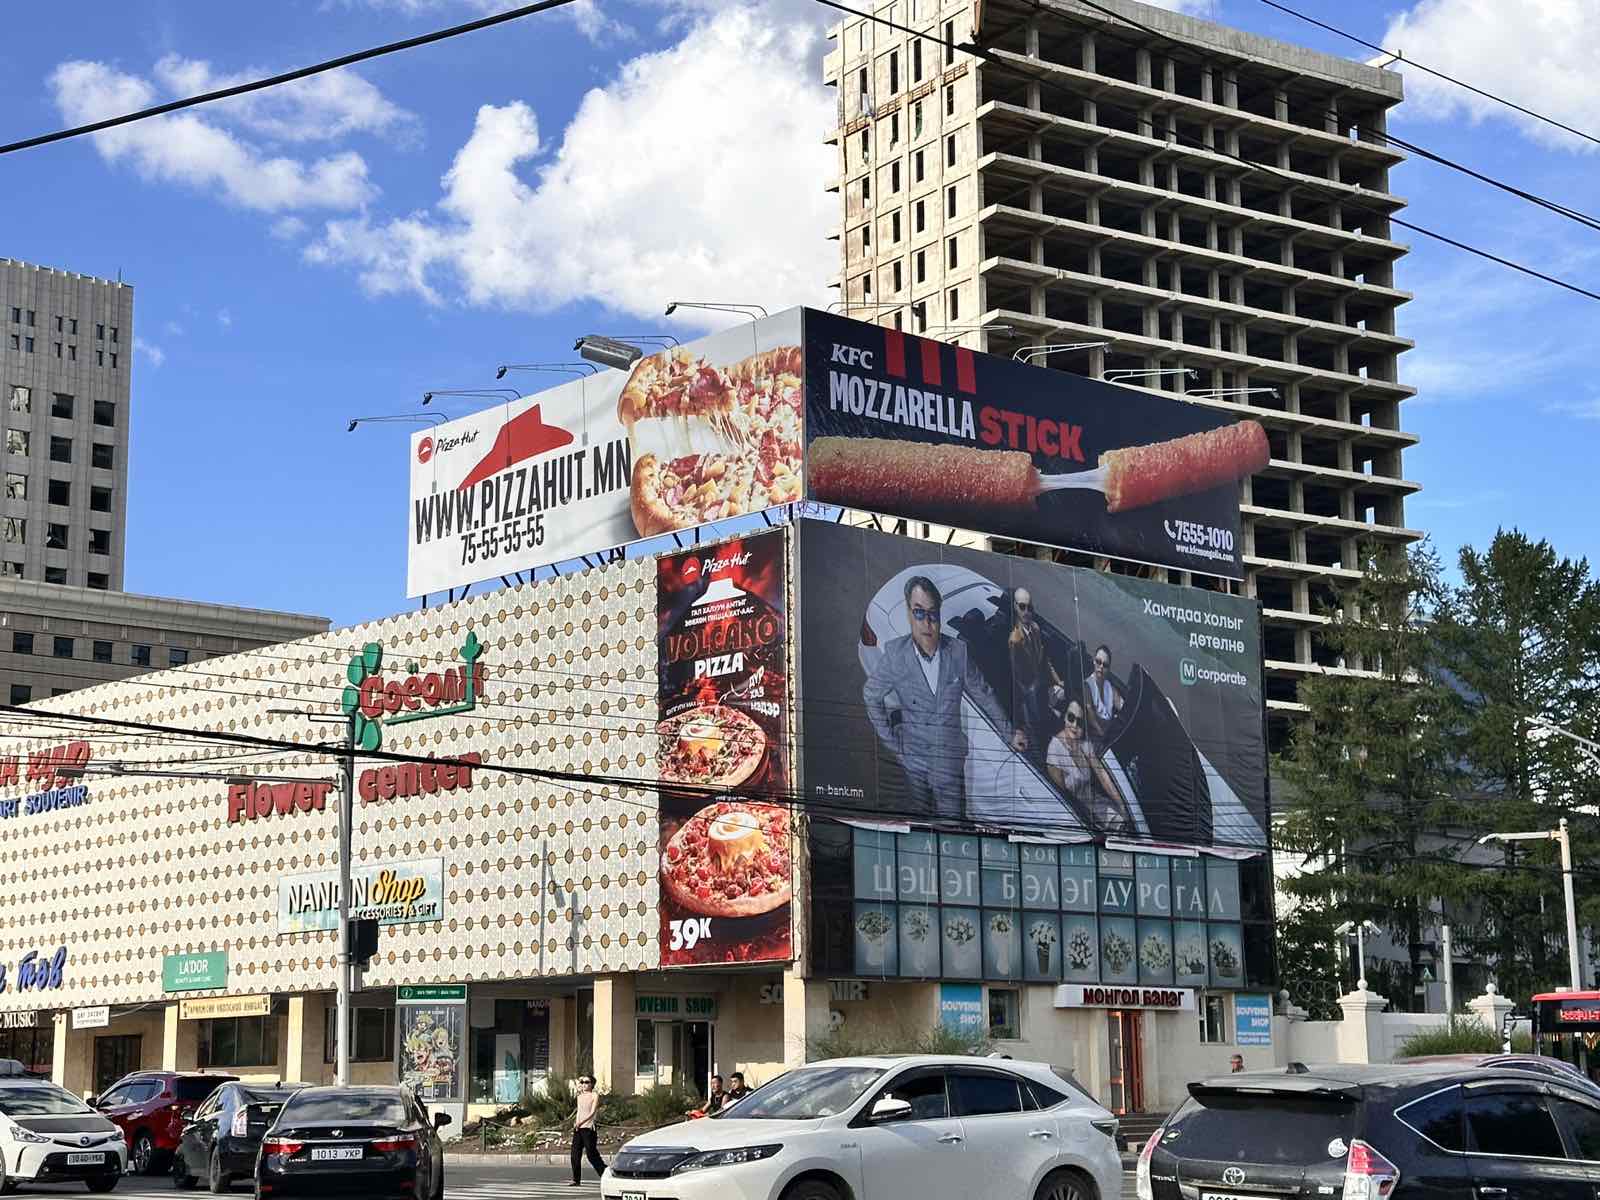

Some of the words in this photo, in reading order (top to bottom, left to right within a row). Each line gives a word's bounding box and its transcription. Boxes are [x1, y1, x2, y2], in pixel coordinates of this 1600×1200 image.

[830, 343, 873, 370] KFC
[829, 370, 976, 440] MOZZARELLA
[435, 436, 460, 455] Pizza
[461, 428, 480, 446] Hut
[980, 406, 1087, 463] STICK
[415, 437, 632, 545] WWW.PIZZAHUT.MN
[461, 514, 545, 566] 75-55-55-55
[1175, 519, 1234, 552] 7555-1010
[701, 556, 730, 576] Pizza
[730, 551, 752, 568] Hut
[1143, 598, 1201, 624] Хамтдаа
[1203, 611, 1244, 631] холыг
[667, 613, 779, 664] VOLCANO
[1189, 632, 1245, 654] дөтөлнө
[694, 651, 744, 680] PIZZA
[1197, 667, 1247, 686] corporate
[25, 785, 89, 816] SOUVENIR
[227, 780, 333, 823] Flower
[359, 751, 482, 802] center
[373, 868, 426, 919] Shop
[873, 863, 977, 898] ЦЭЦЭГ
[1002, 872, 1093, 904] БЭЛЭГ
[1103, 878, 1224, 913] ДУРСГАЛ
[418, 902, 437, 916] GIFT
[669, 917, 712, 951] 39K
[1083, 988, 1140, 1006] МОНГОЛ
[4, 1011, 36, 1029] MUSIC
[316, 1150, 338, 1160] 1013
